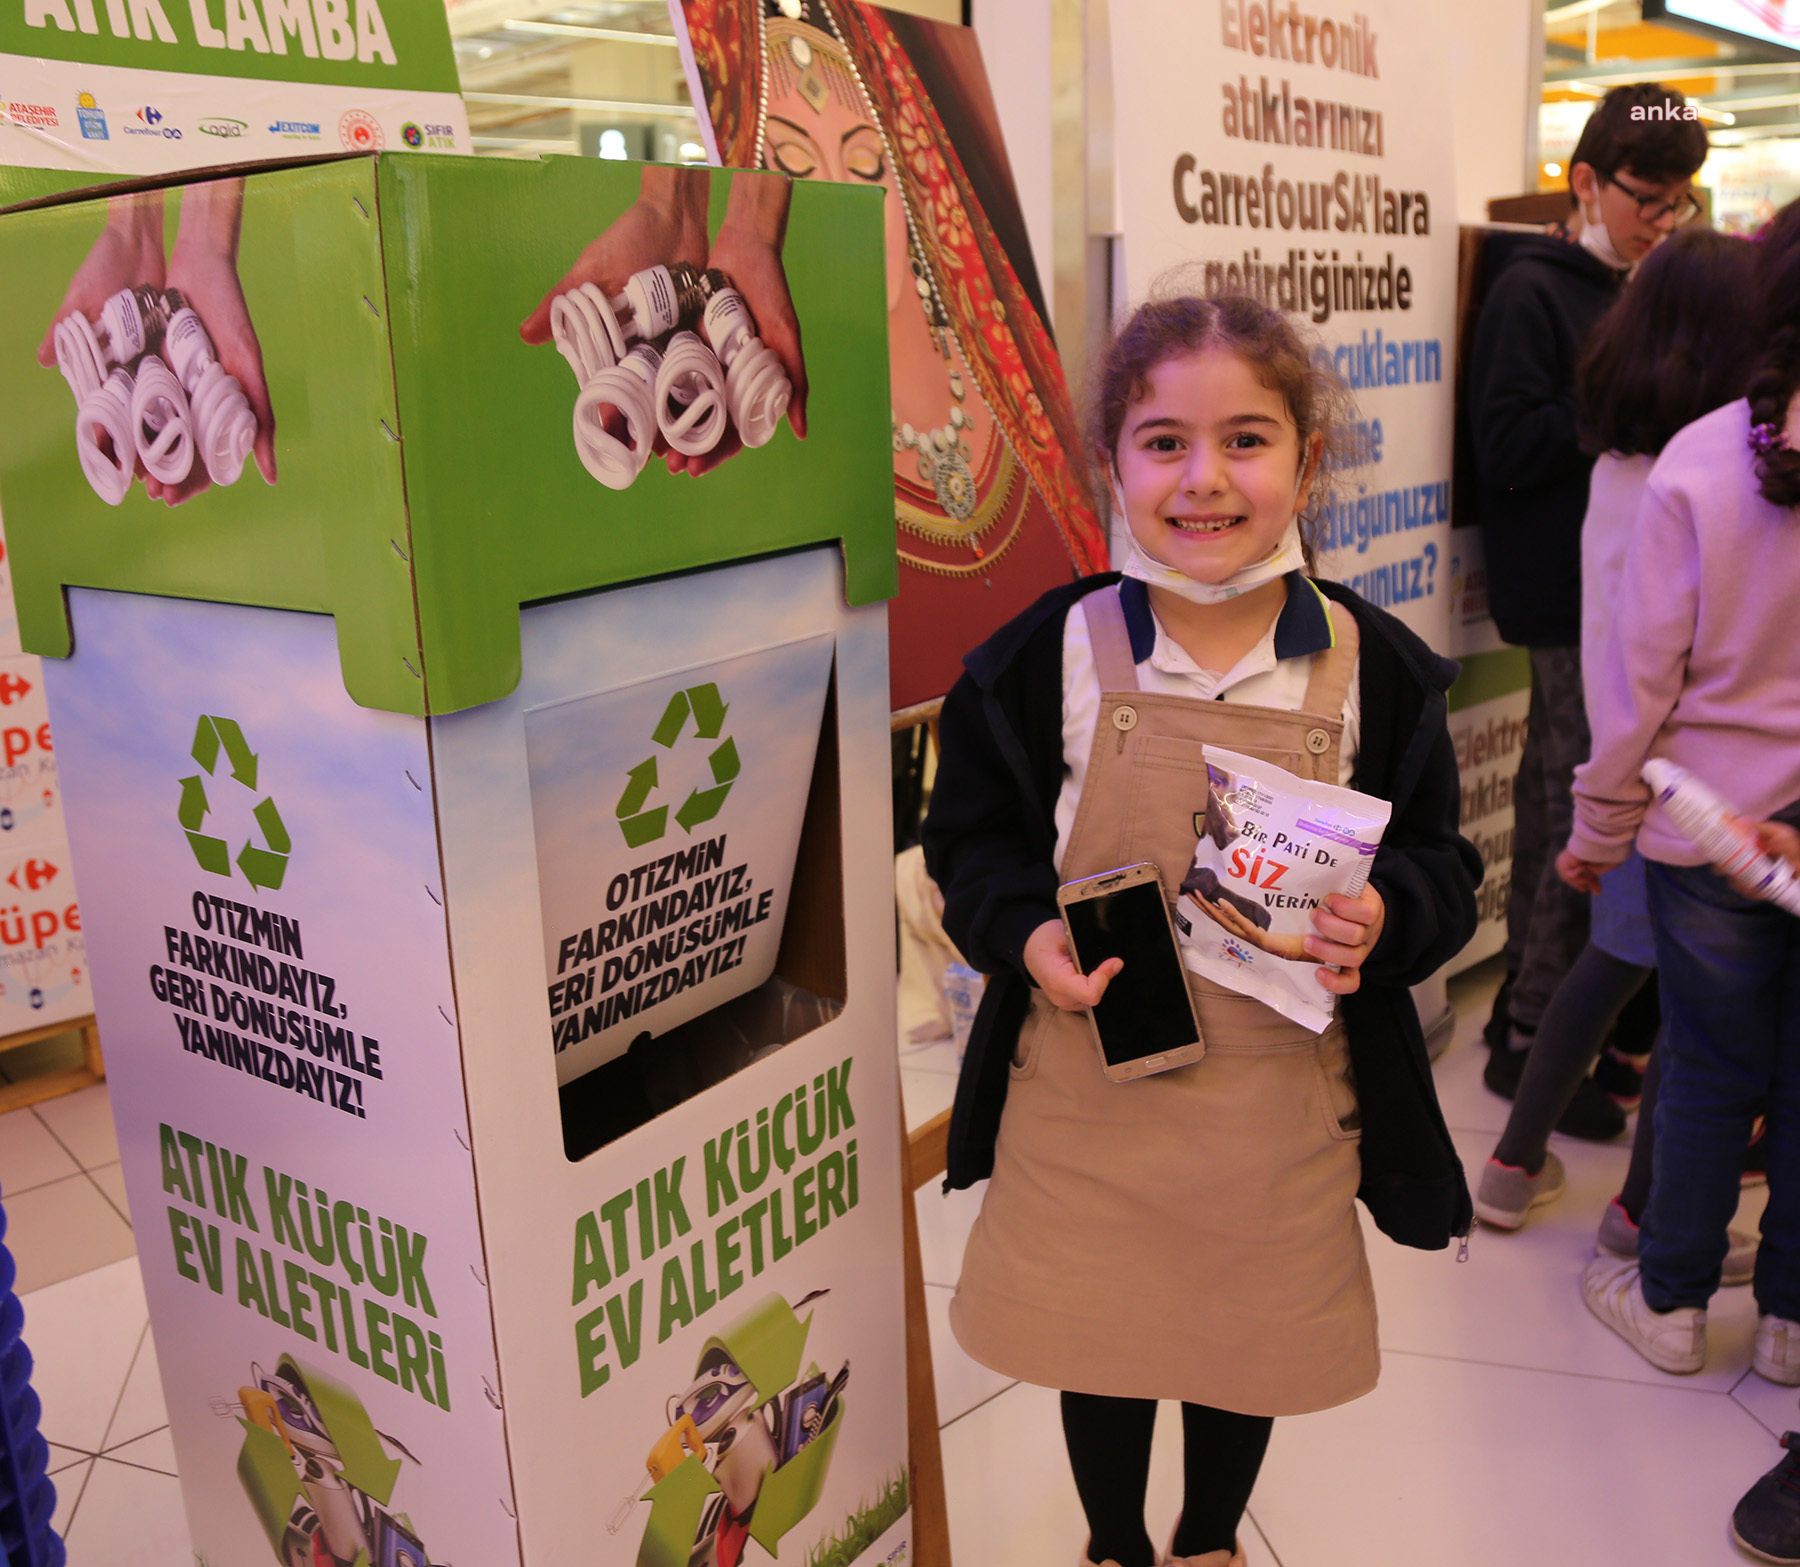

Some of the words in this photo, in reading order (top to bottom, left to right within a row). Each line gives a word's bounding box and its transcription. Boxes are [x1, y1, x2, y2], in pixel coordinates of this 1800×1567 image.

[188, 0, 398, 65] LAMBA
[1220, 0, 1380, 79] Elektronik
[1173, 152, 1431, 236] CarrefourSA'lara
[557, 863, 753, 975] FARKINDAYIZ,
[605, 833, 727, 911] OTİZMİN
[164, 925, 347, 1019] FARKINDAYIZ,
[192, 890, 304, 960] OTİZMİN
[150, 964, 208, 1017] GERİ
[551, 934, 747, 1055] YANINIZDAYIZ!
[173, 1012, 367, 1119] YANINIZDAYIZ!
[159, 1122, 260, 1233] ATIK
[263, 1165, 438, 1319] KÜÇÜK
[572, 1155, 692, 1306] ATIK
[703, 1056, 856, 1218] KÜÇÜK
[167, 1205, 223, 1295] EV
[235, 1237, 451, 1412] ALETLERİ
[575, 1278, 644, 1399] EV
[658, 1138, 859, 1344] ALETLERİ
